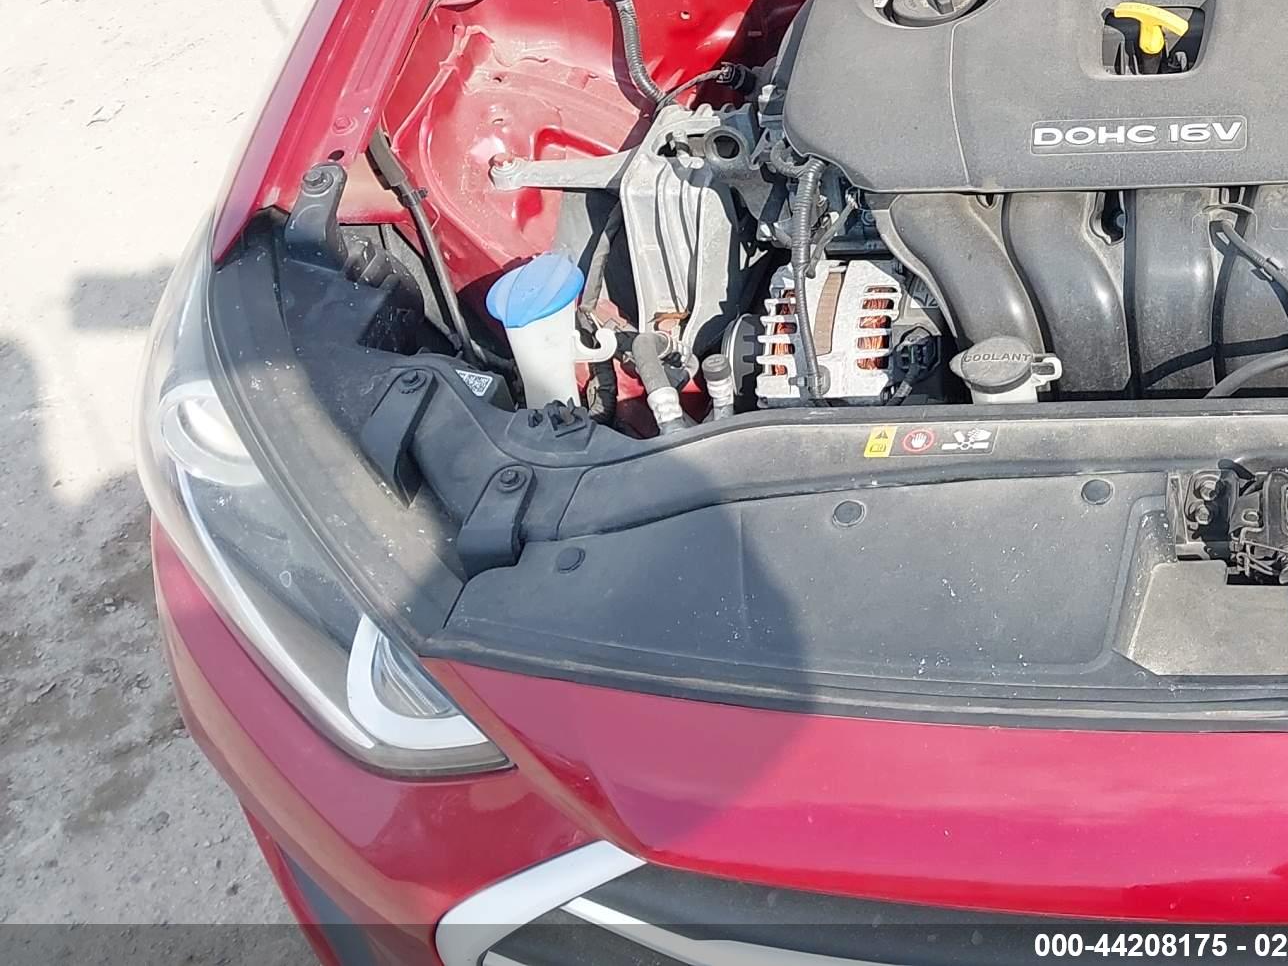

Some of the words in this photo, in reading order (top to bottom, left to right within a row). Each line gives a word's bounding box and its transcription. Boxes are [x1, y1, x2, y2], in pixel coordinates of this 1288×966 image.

[1033, 124, 1157, 146] DOHC
[1168, 121, 1243, 142] 16V
[963, 353, 1031, 363] COOLANT
